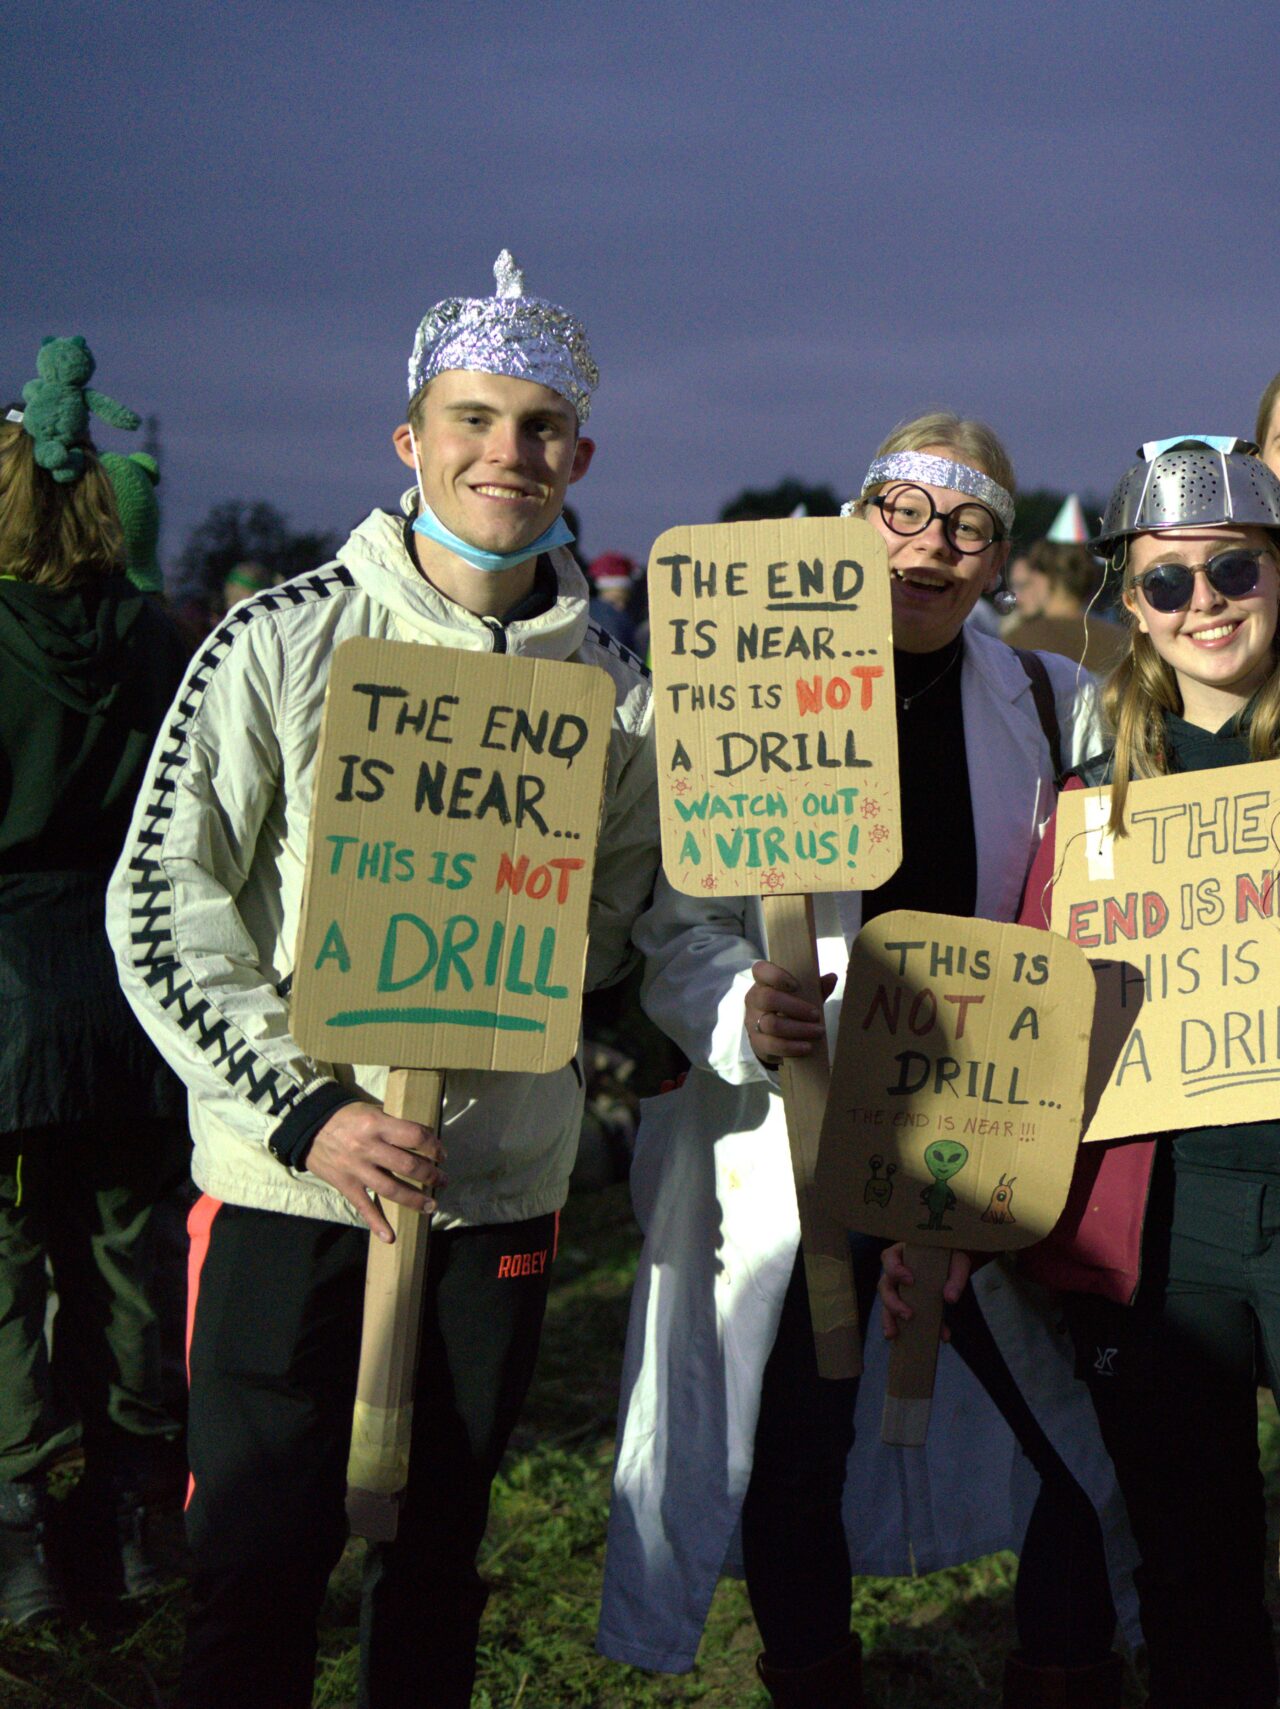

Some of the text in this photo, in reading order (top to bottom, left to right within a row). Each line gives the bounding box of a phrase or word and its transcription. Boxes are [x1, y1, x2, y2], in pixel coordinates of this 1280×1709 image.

[657, 554, 864, 600] THE END
[670, 619, 878, 662] IS NEAR...
[667, 665, 885, 716] THIS IS NOT
[353, 683, 589, 767] THE END
[671, 730, 872, 777] A DRILL
[335, 754, 581, 841] IS NEAR...
[675, 788, 859, 822] WATCH OUT
[679, 825, 859, 869] A VIRUS!
[1131, 791, 1270, 864] THE
[326, 835, 585, 905] THIS IS NOT
[1069, 891, 1169, 948] END
[1181, 878, 1224, 930] IS
[314, 912, 570, 999] A DRILL
[884, 941, 1049, 985] THIS IS
[1222, 940, 1260, 986] IS
[862, 985, 1039, 1040] NOT A
[887, 1050, 1061, 1110] DRILL...
[1116, 1028, 1152, 1086] A
[847, 1108, 883, 1124] THE
[893, 1113, 929, 1128] END
[938, 1116, 955, 1131] IS
[498, 1249, 548, 1278] ROBEY
